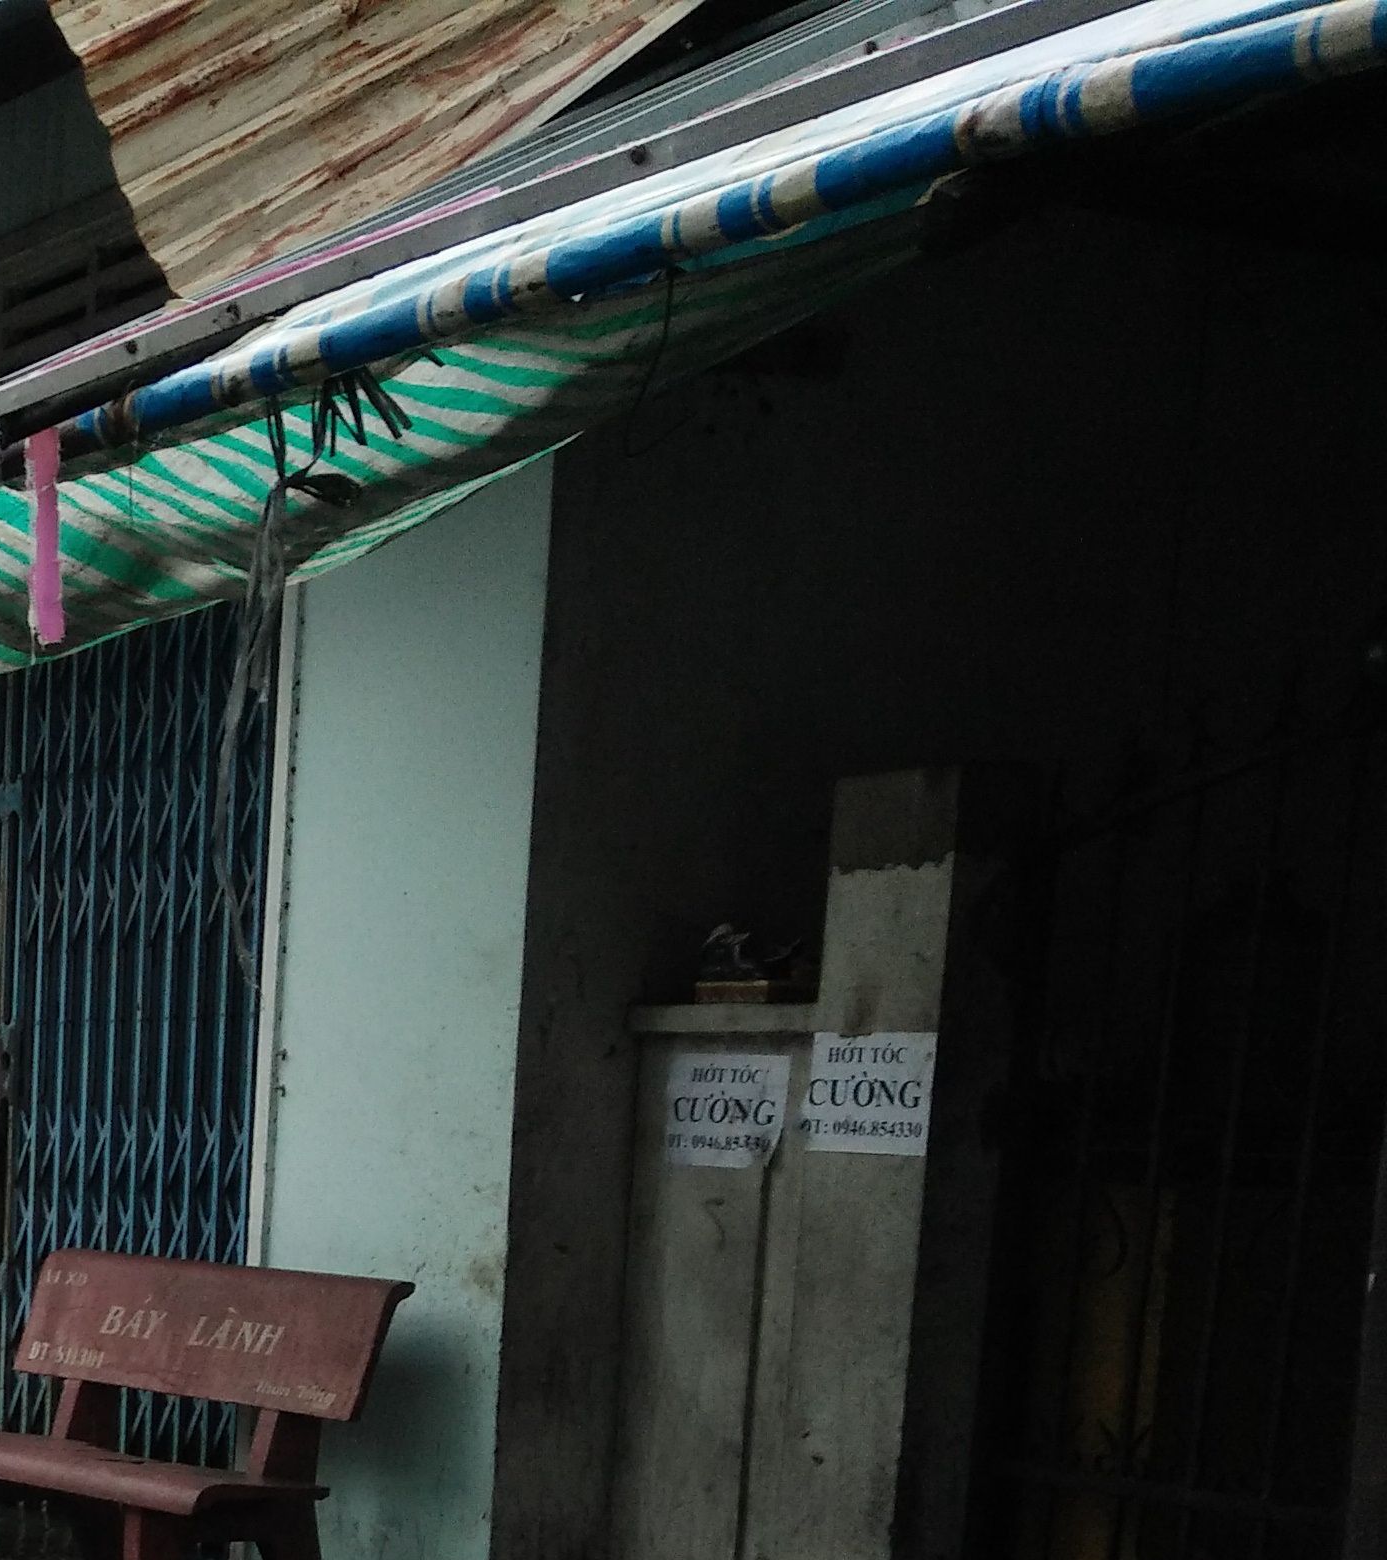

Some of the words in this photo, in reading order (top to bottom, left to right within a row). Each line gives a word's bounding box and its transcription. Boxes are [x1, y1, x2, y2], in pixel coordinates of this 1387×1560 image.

[827, 1042, 865, 1063] HỚT
[871, 1042, 908, 1063] TÓC
[692, 1063, 727, 1083] HỚT
[730, 1064, 763, 1084] TÓC
[809, 1071, 922, 1108] CƯỜNG
[674, 1090, 776, 1126] CƯỜNG
[188, 1307, 286, 1355] LÀNH
